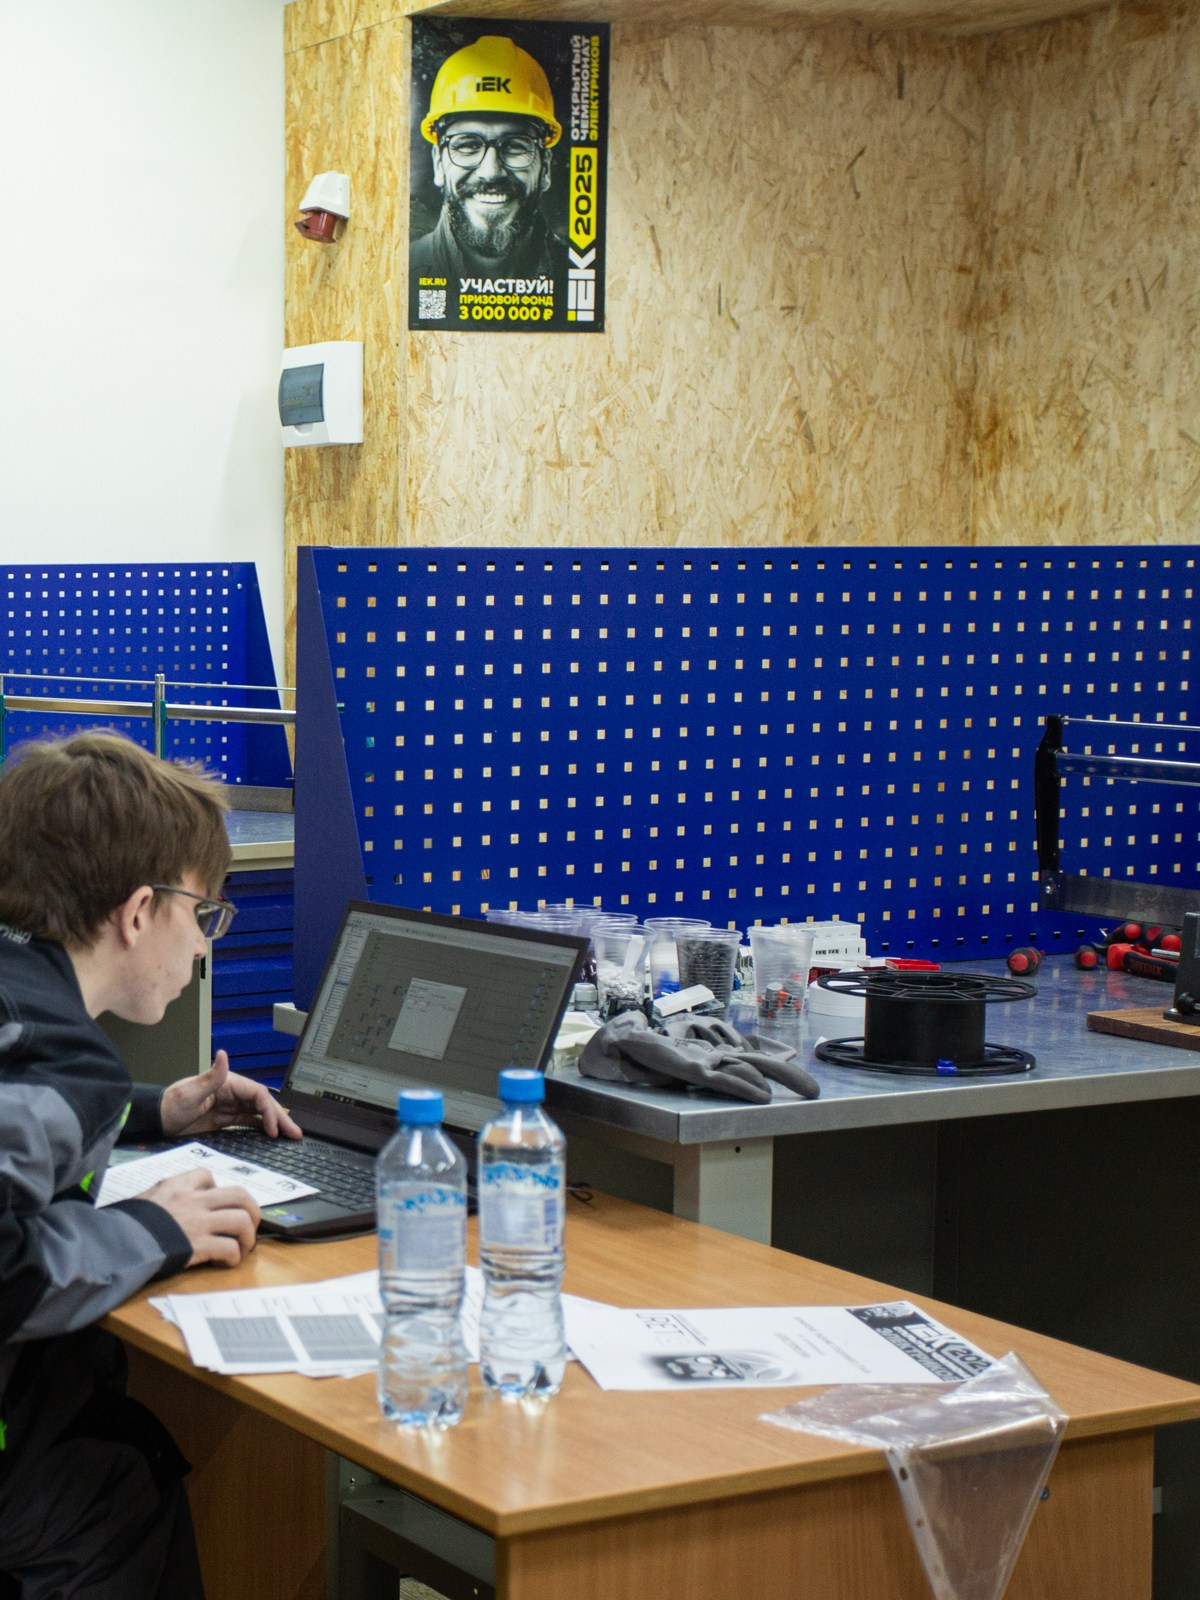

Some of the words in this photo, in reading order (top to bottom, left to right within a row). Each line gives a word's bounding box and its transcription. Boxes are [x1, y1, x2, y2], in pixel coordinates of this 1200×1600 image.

[571, 35, 581, 141] ОТКРЫТЫЙ
[580, 35, 590, 141] ЧЕМПИОНАТ
[589, 35, 601, 141] ЭЛЕКТРИКОВ
[575, 154, 593, 236] 2025
[419, 277, 447, 286] IEK.RU
[459, 275, 554, 294] УЧАСТВУЙ!
[459, 293, 520, 305] ПРИЗОВОЙ
[521, 295, 554, 306] ФОНД
[459, 305, 469, 320] 3
[471, 306, 505, 320] 000
[508, 306, 541, 320] 000
